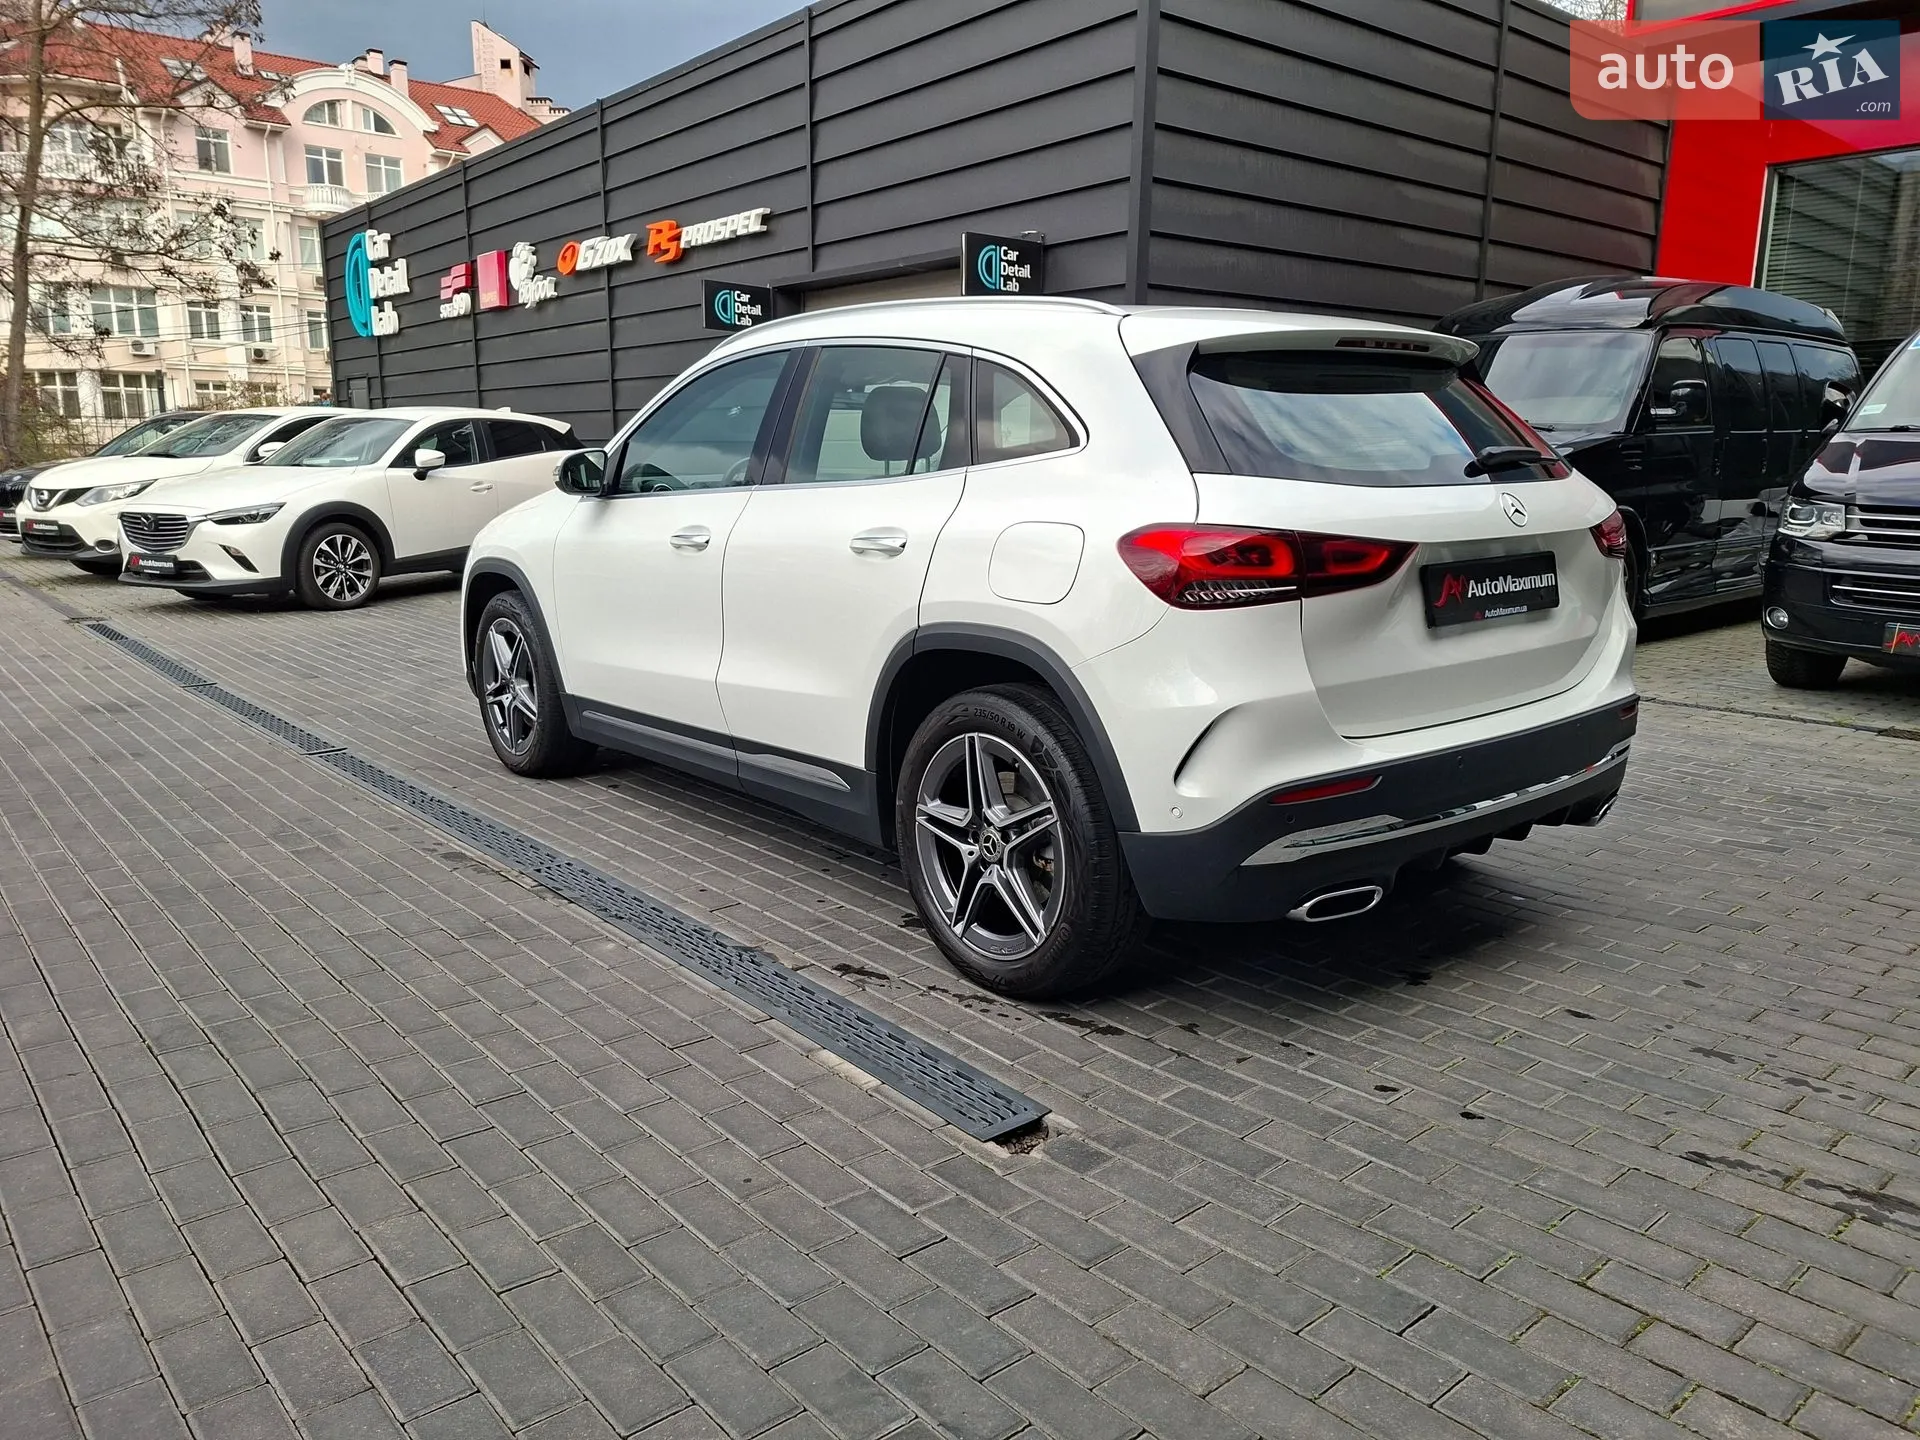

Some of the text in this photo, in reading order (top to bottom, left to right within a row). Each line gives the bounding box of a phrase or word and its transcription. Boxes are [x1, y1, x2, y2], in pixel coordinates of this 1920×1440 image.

[679, 207, 771, 249] PROSPEC
[365, 229, 391, 261] Car
[1000, 246, 1019, 261] Car
[367, 258, 410, 299] Detail
[1000, 261, 1031, 278] Detail
[1000, 277, 1019, 292] Lab
[734, 290, 751, 303] Car
[370, 301, 399, 336] Lab
[734, 302, 762, 316] Detail
[735, 314, 752, 326] Lab
[1467, 573, 1556, 598] AutoMaximum
[974, 707, 1000, 723] 235/50
[1000, 716, 1007, 727] R
[1007, 721, 1016, 732] 19
